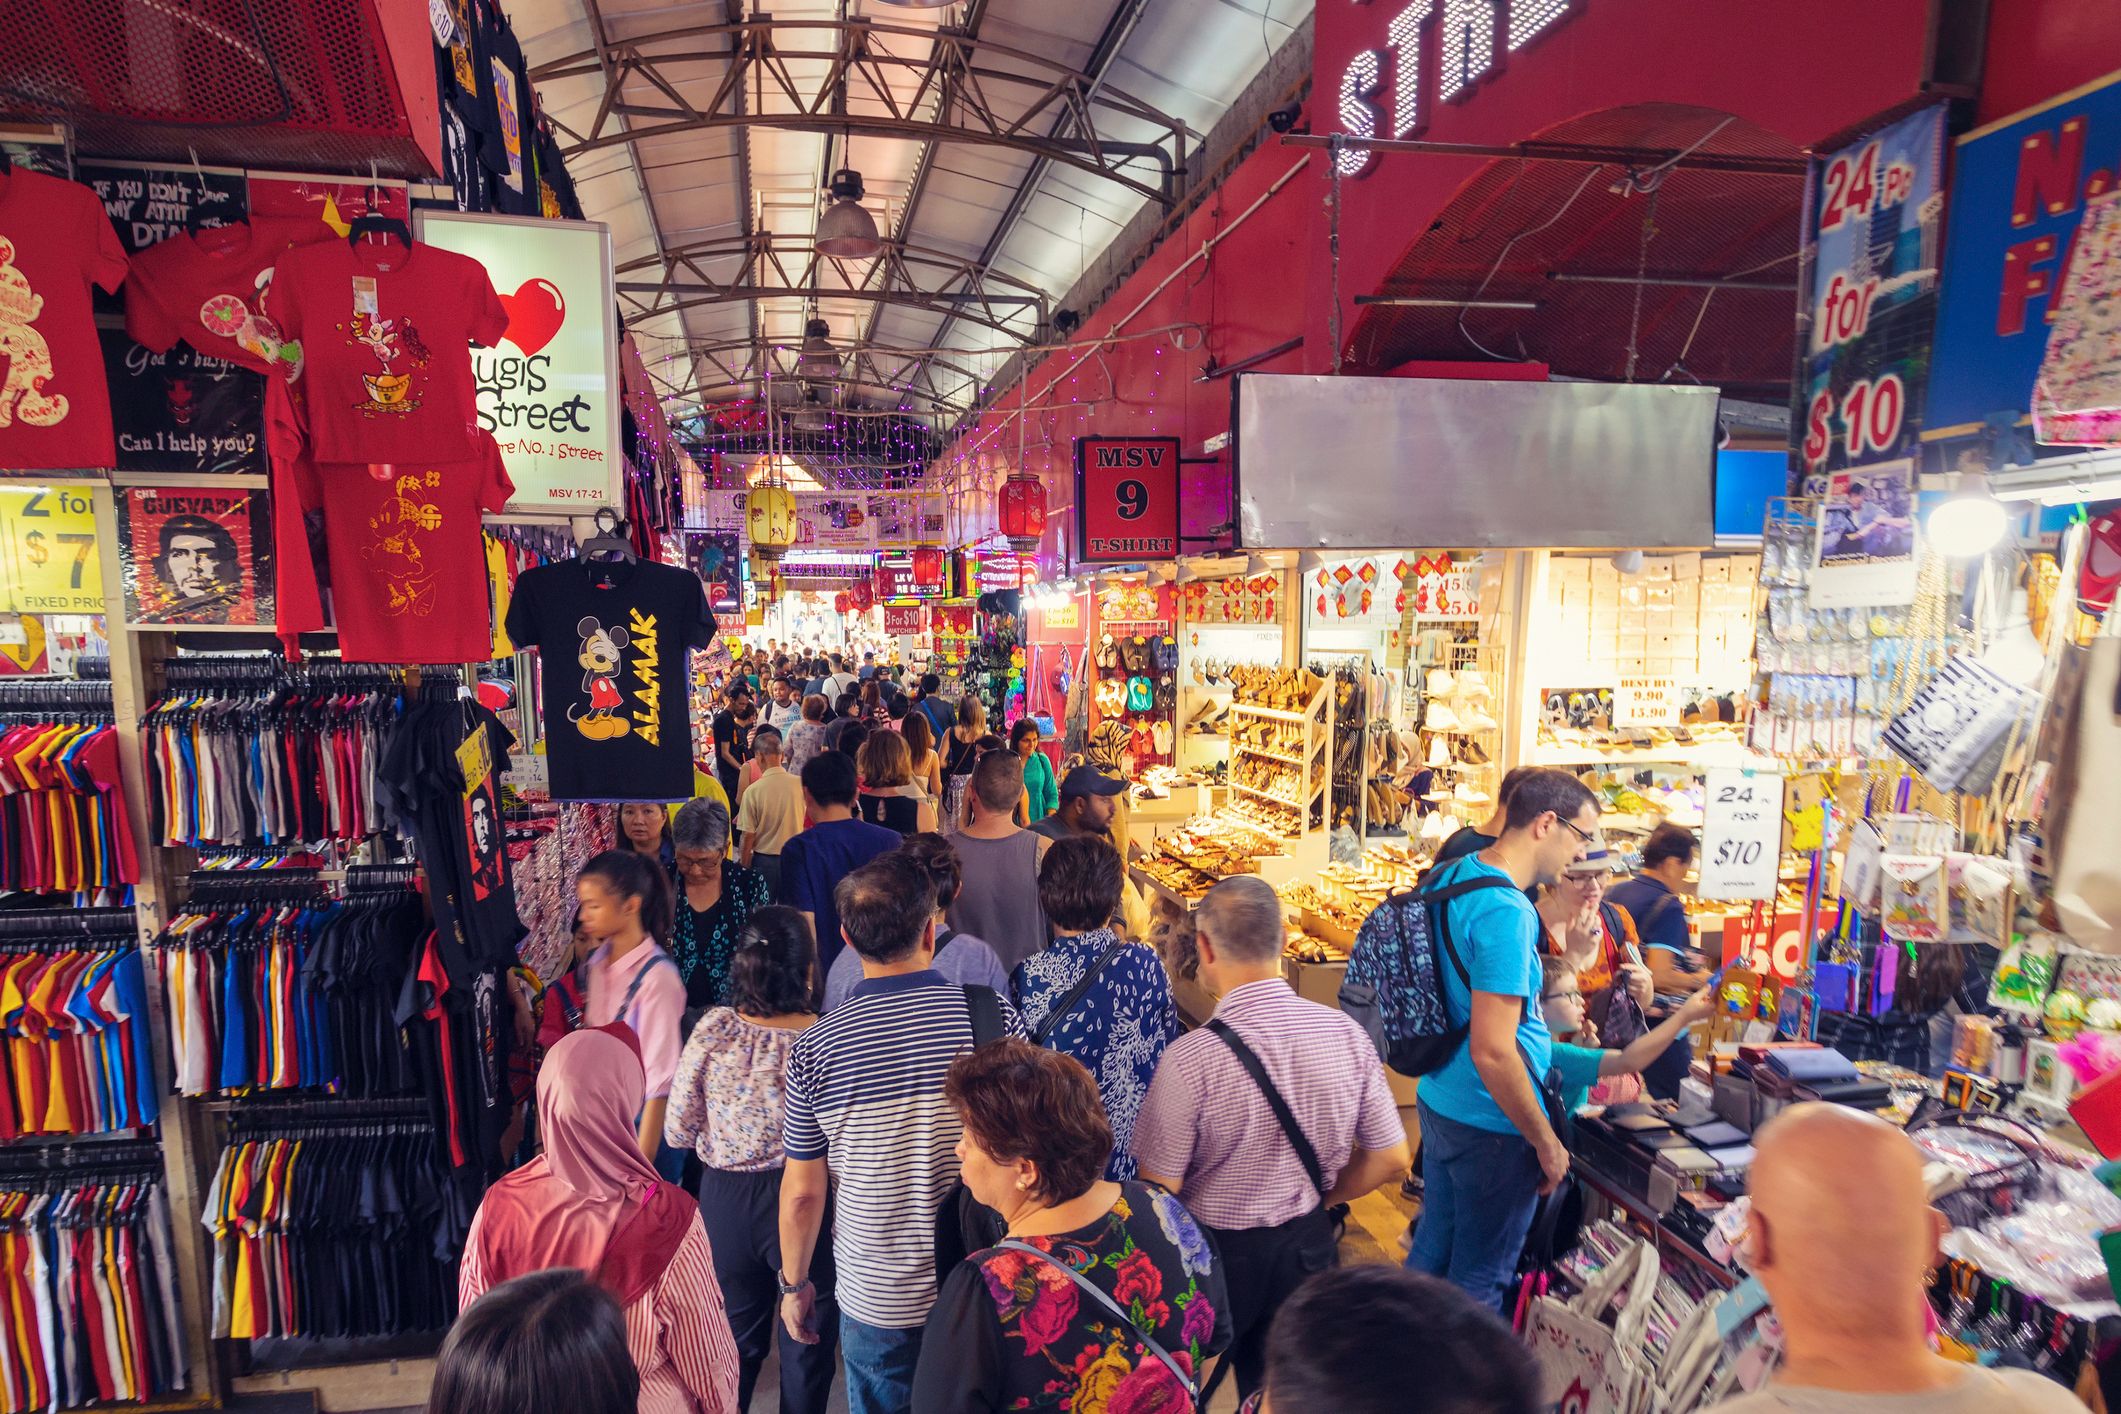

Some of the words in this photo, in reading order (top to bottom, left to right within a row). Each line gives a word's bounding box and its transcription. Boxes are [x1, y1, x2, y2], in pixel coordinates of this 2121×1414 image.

[93, 180, 111, 199] IF
[117, 181, 143, 199] YOU
[150, 181, 192, 203] DON'T
[1820, 143, 1880, 230] 24
[105, 201, 135, 221] MY
[1823, 276, 1877, 345] for
[476, 355, 551, 396] ugis
[476, 386, 592, 434] Street
[119, 433, 153, 452] Can
[156, 431, 164, 451] I
[168, 431, 207, 457] help
[211, 433, 256, 457] you?
[519, 438, 545, 455] No.
[548, 444, 554, 456] 1
[558, 443, 603, 461] Street
[1096, 447, 1166, 468] MSV
[22, 486, 51, 518] 2
[134, 489, 157, 499] CHE
[549, 489, 573, 498] MSV
[576, 489, 603, 499] 17-21
[1115, 479, 1149, 520] 9
[142, 497, 249, 516] GUEVARA
[1091, 538, 1173, 553] T-SHIRT
[56, 533, 95, 589] 7
[25, 596, 69, 608] FIXED
[73, 597, 105, 609] PRIC
[885, 611, 891, 626] 3
[891, 614, 902, 625] For
[903, 609, 918, 627] $10
[887, 627, 917, 635] WATCHES
[629, 607, 661, 747] ALAMAK
[1620, 679, 1649, 688] BEST
[1633, 690, 1664, 702] 9.90
[1630, 707, 1668, 719] 15.90
[1716, 786, 1754, 803] 24
[1732, 812, 1760, 822] FOR
[1713, 838, 1763, 867] $10
